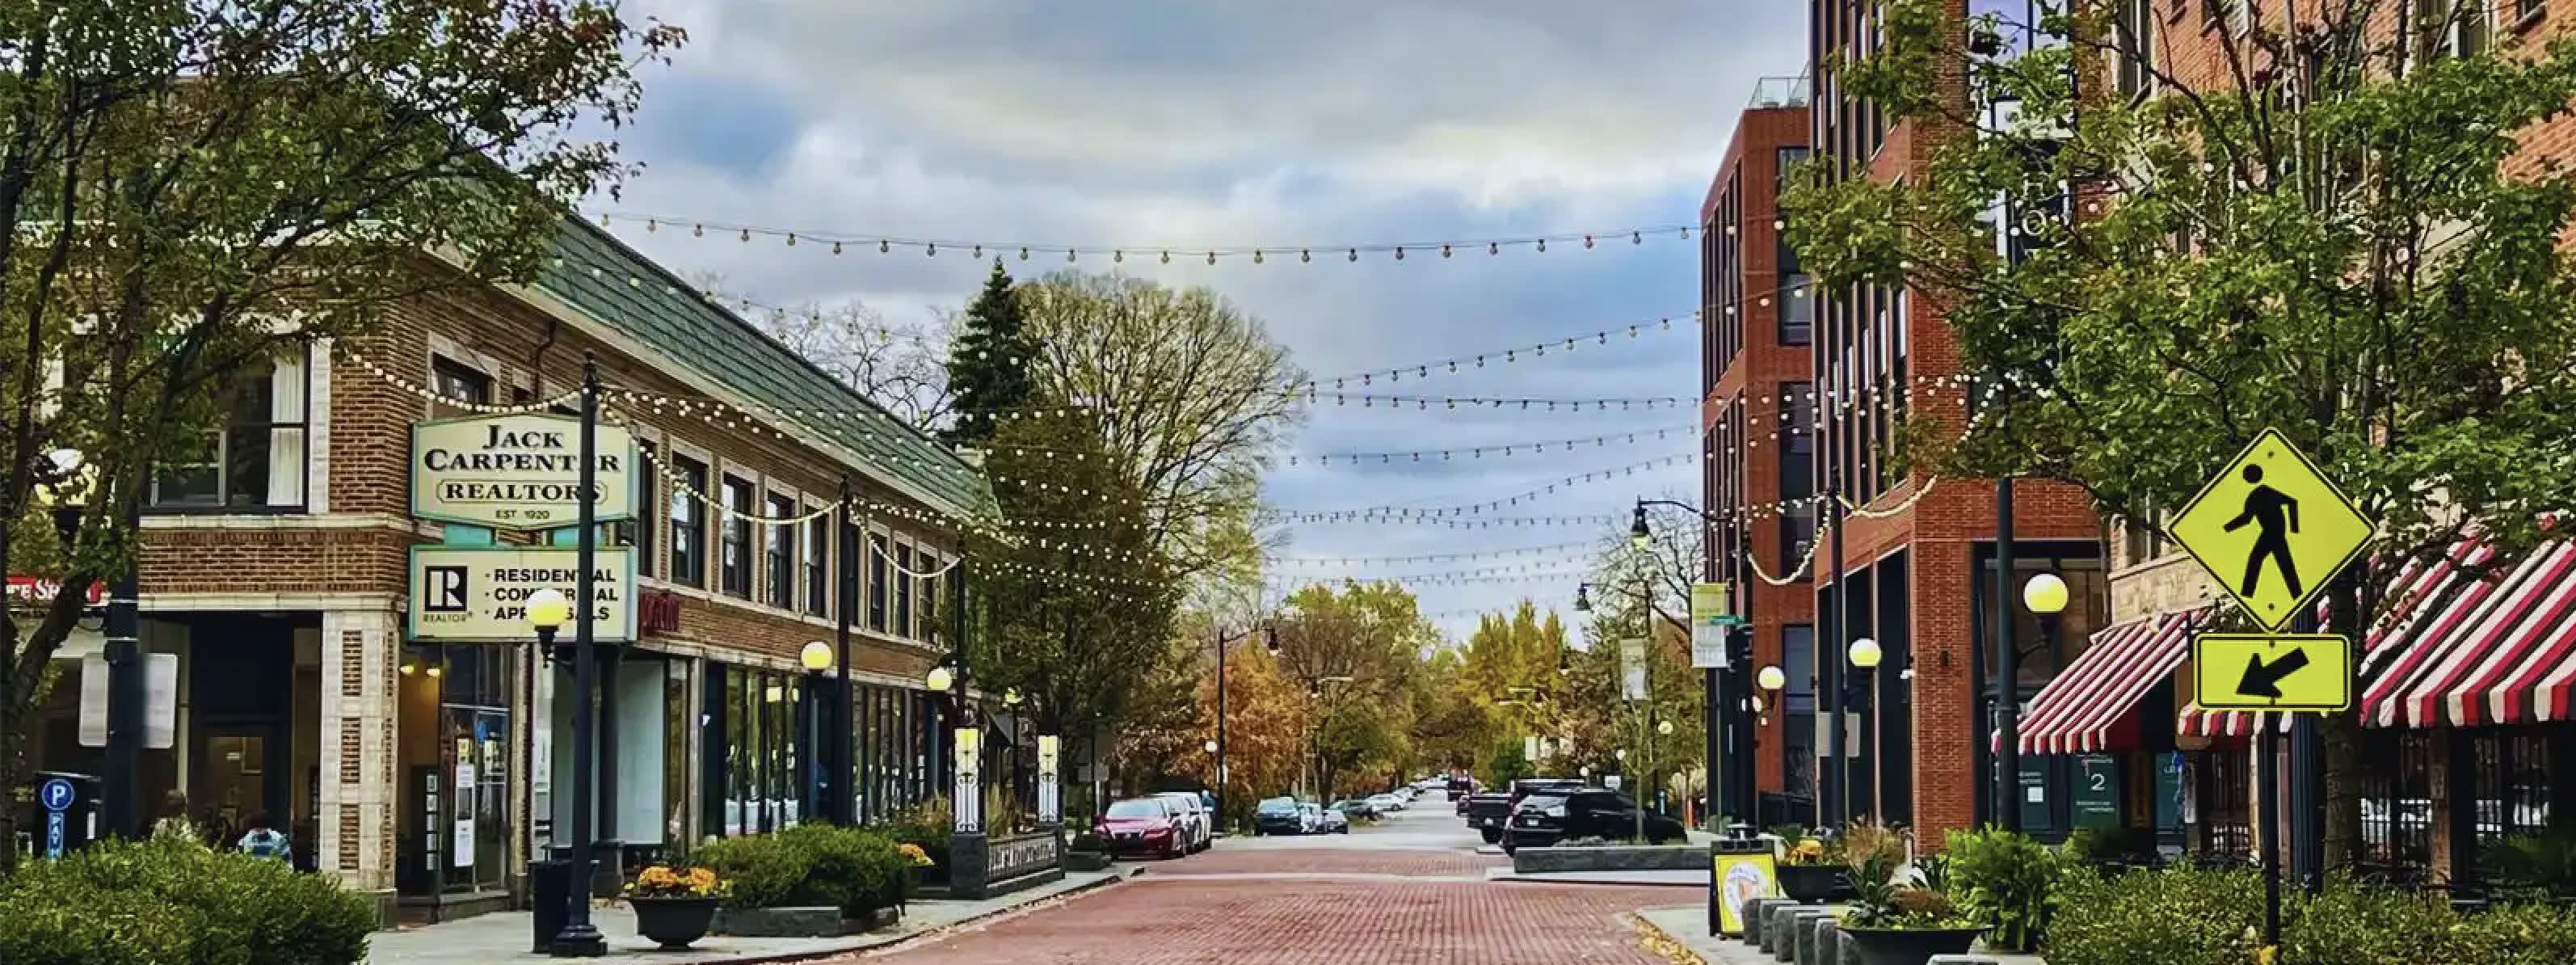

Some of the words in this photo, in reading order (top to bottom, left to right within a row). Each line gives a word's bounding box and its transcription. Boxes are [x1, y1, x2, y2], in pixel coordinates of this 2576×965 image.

[482, 425, 564, 449] JACK
[424, 449, 621, 472] CARPENTR
[494, 568, 617, 583] RESIDENAL
[494, 588, 619, 601] COMRAL
[2090, 773, 2106, 791] 2
[51, 785, 66, 806] P
